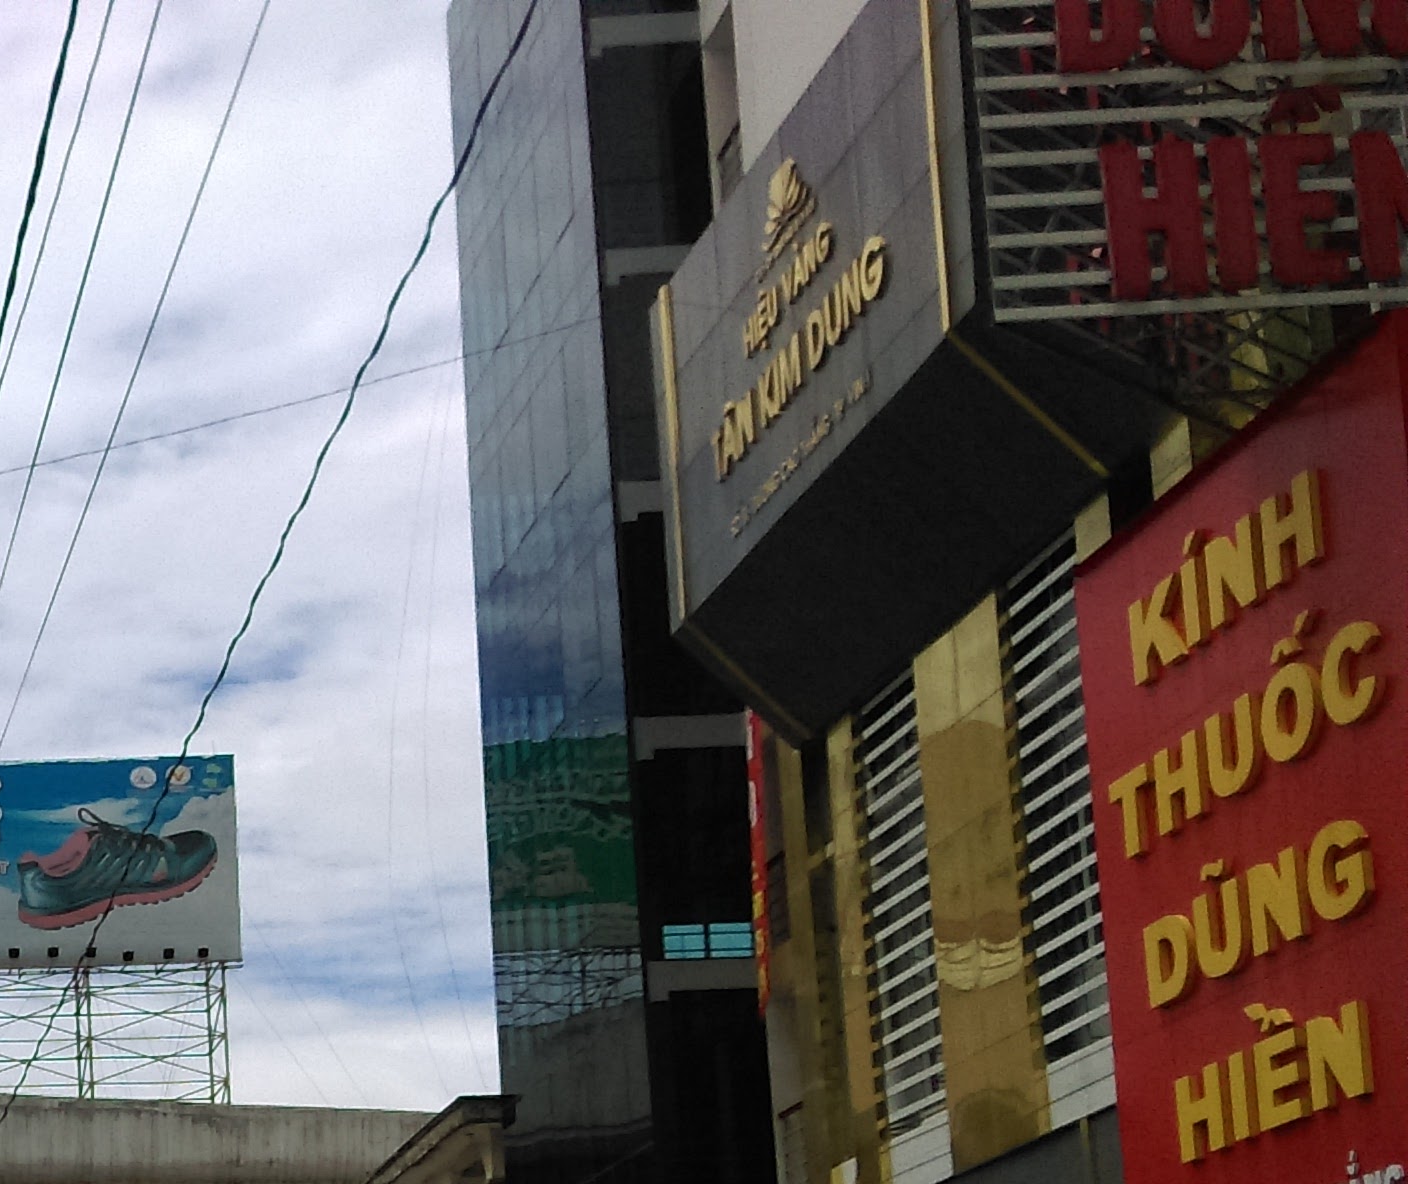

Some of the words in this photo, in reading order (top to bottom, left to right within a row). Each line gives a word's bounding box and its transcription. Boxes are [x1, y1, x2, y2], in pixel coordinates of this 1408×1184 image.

[712, 389, 756, 482] TÂN
[758, 332, 802, 429] KIM
[805, 235, 885, 371] DUNG
[742, 288, 779, 358] HIỆU
[1128, 470, 1326, 686] KÍNH
[1109, 609, 1381, 858] THUỐC
[1143, 820, 1375, 1009] DŨNG
[1174, 1000, 1374, 1164] HIỀN
